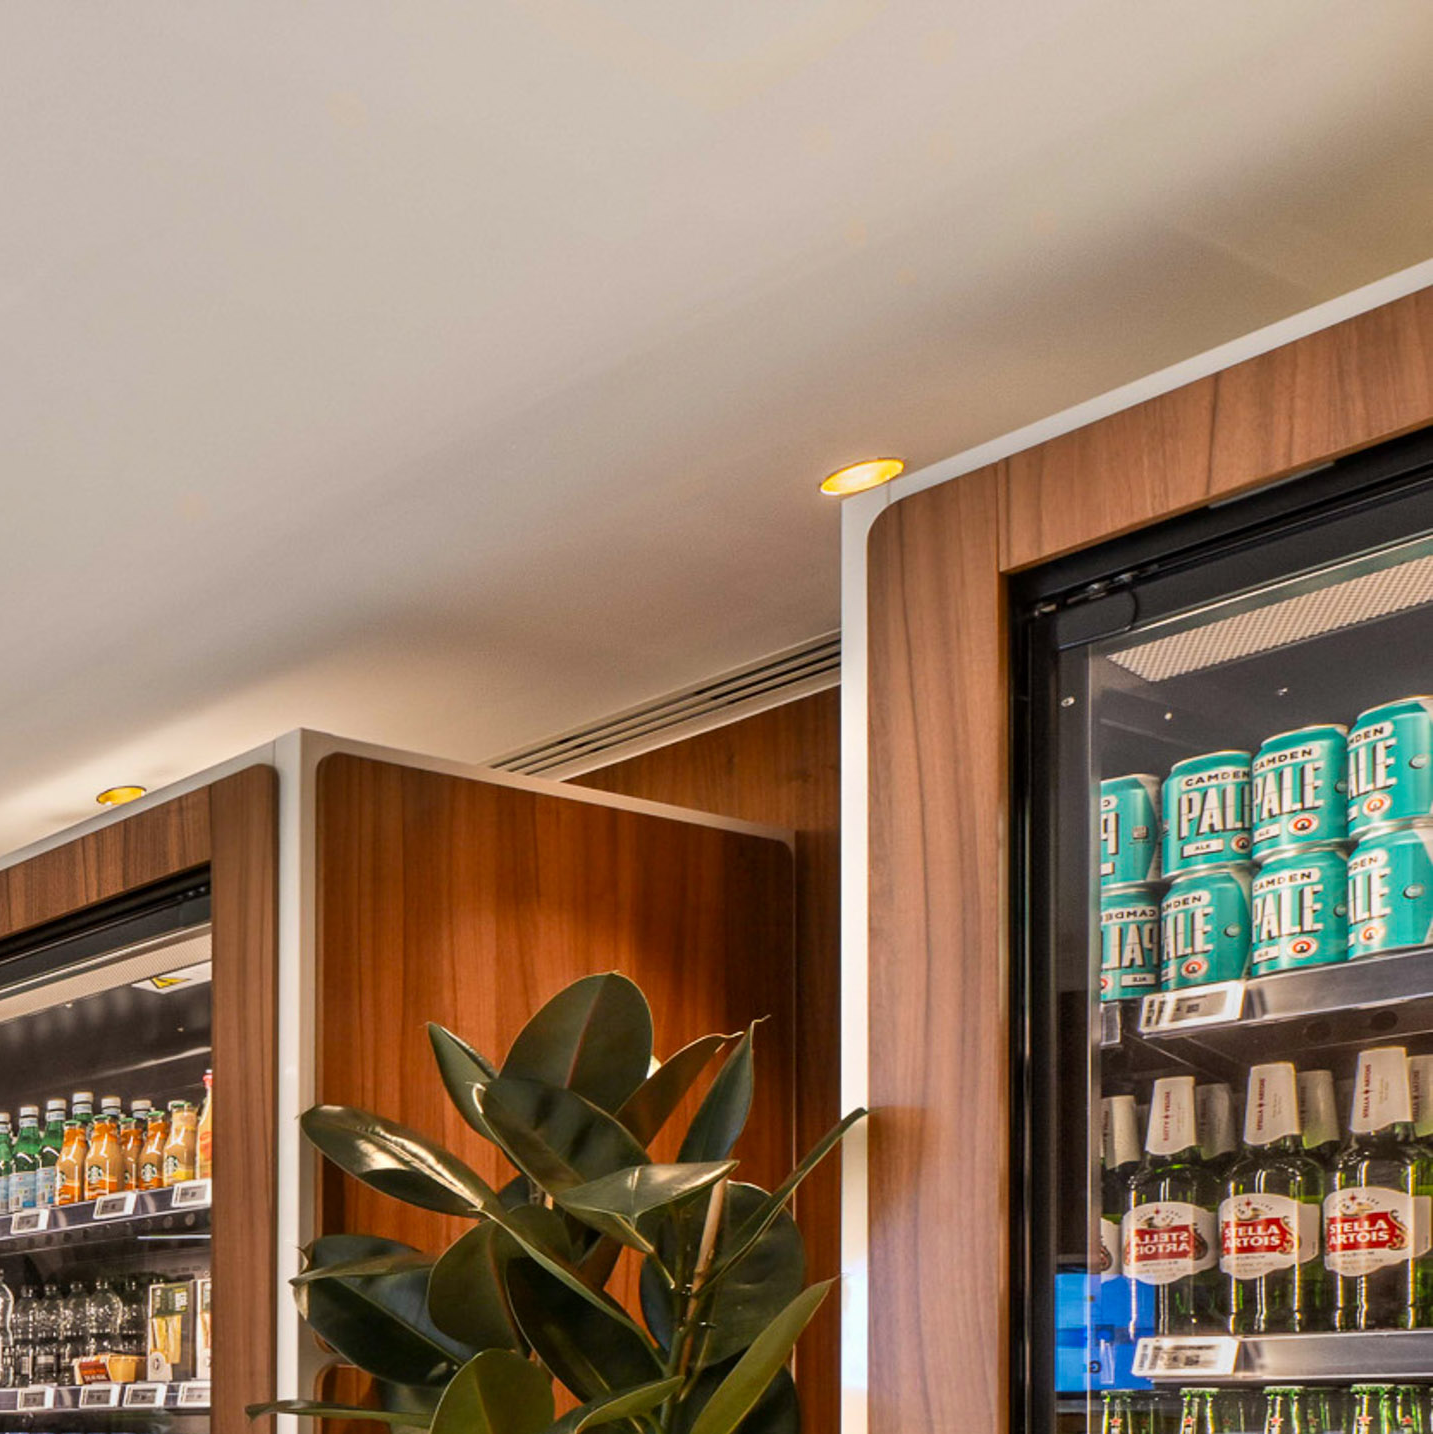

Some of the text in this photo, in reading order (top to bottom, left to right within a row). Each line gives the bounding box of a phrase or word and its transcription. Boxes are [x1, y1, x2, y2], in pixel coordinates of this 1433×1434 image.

[1184, 769, 1250, 788] CAMDEN
[1253, 761, 1324, 822] PALE
[1178, 786, 1251, 841] PAL
[1253, 884, 1324, 943] PALE
[1224, 1222, 1281, 1239] STELLA
[1329, 1218, 1390, 1234] STELLA
[1224, 1234, 1281, 1248] ARTOIS
[1329, 1229, 1390, 1246] ARTOIS
